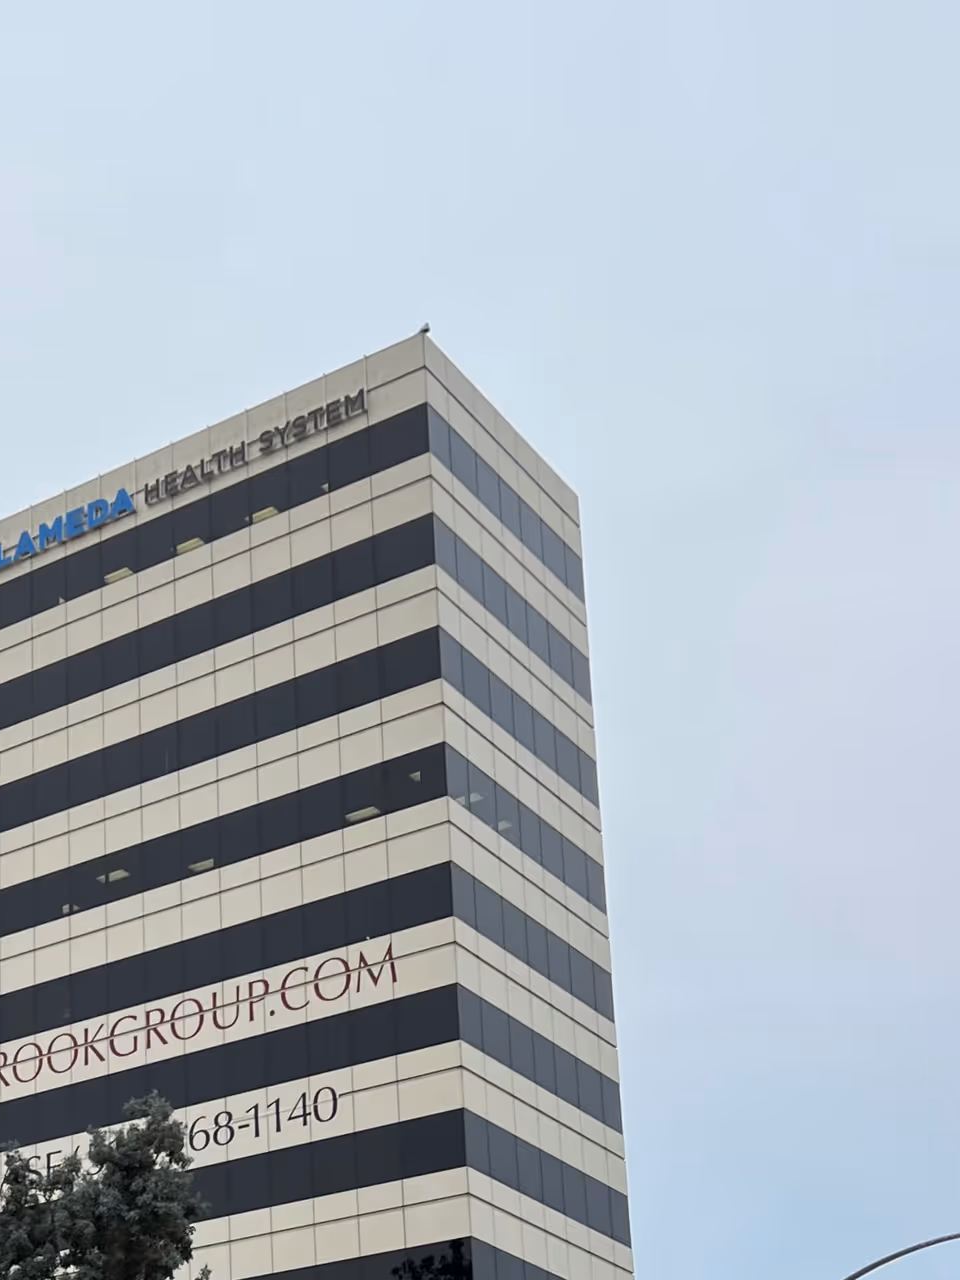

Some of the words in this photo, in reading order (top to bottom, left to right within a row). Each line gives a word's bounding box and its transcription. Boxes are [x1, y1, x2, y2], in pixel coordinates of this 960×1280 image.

[144, 440, 249, 505] HEALTH
[258, 387, 368, 452] SYSTEM
[188, 1086, 339, 1152] 68-1140
